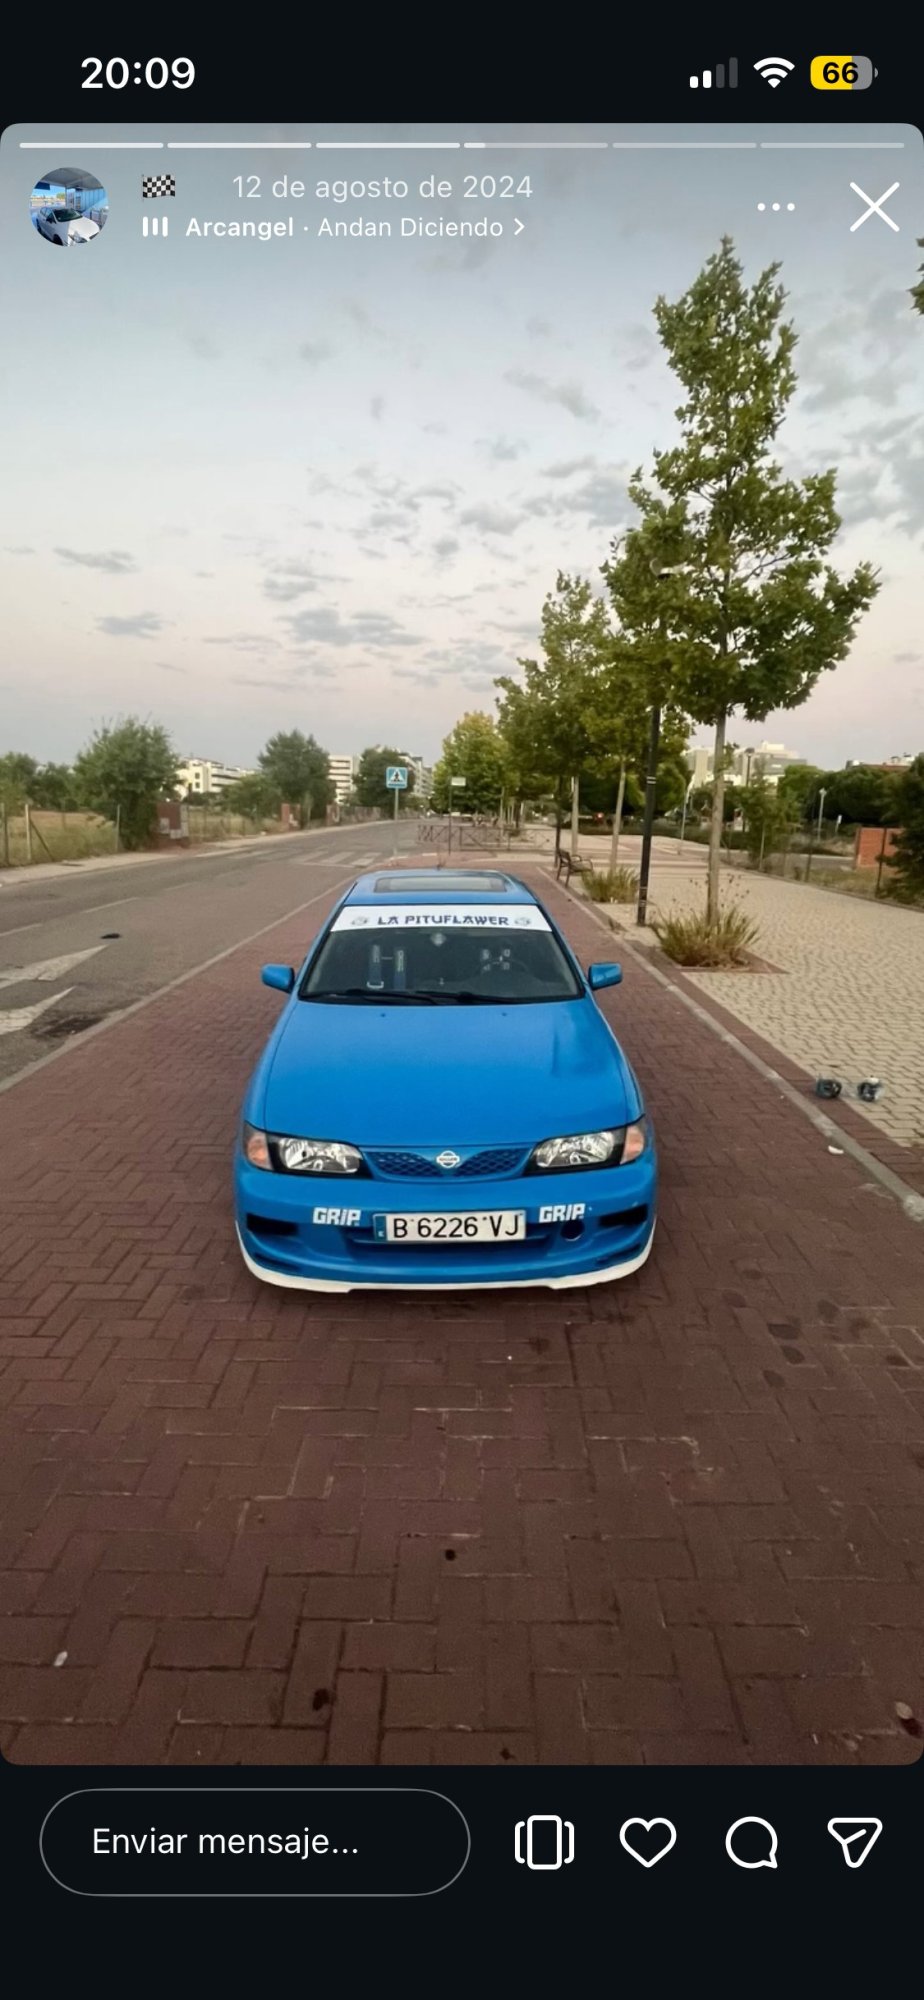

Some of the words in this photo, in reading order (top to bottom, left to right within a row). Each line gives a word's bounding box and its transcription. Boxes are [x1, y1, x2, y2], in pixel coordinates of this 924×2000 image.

[377, 916, 399, 925] LA
[393, 1218, 408, 1238] B
[417, 1216, 478, 1238] 6226
[489, 1214, 520, 1236] VJ
